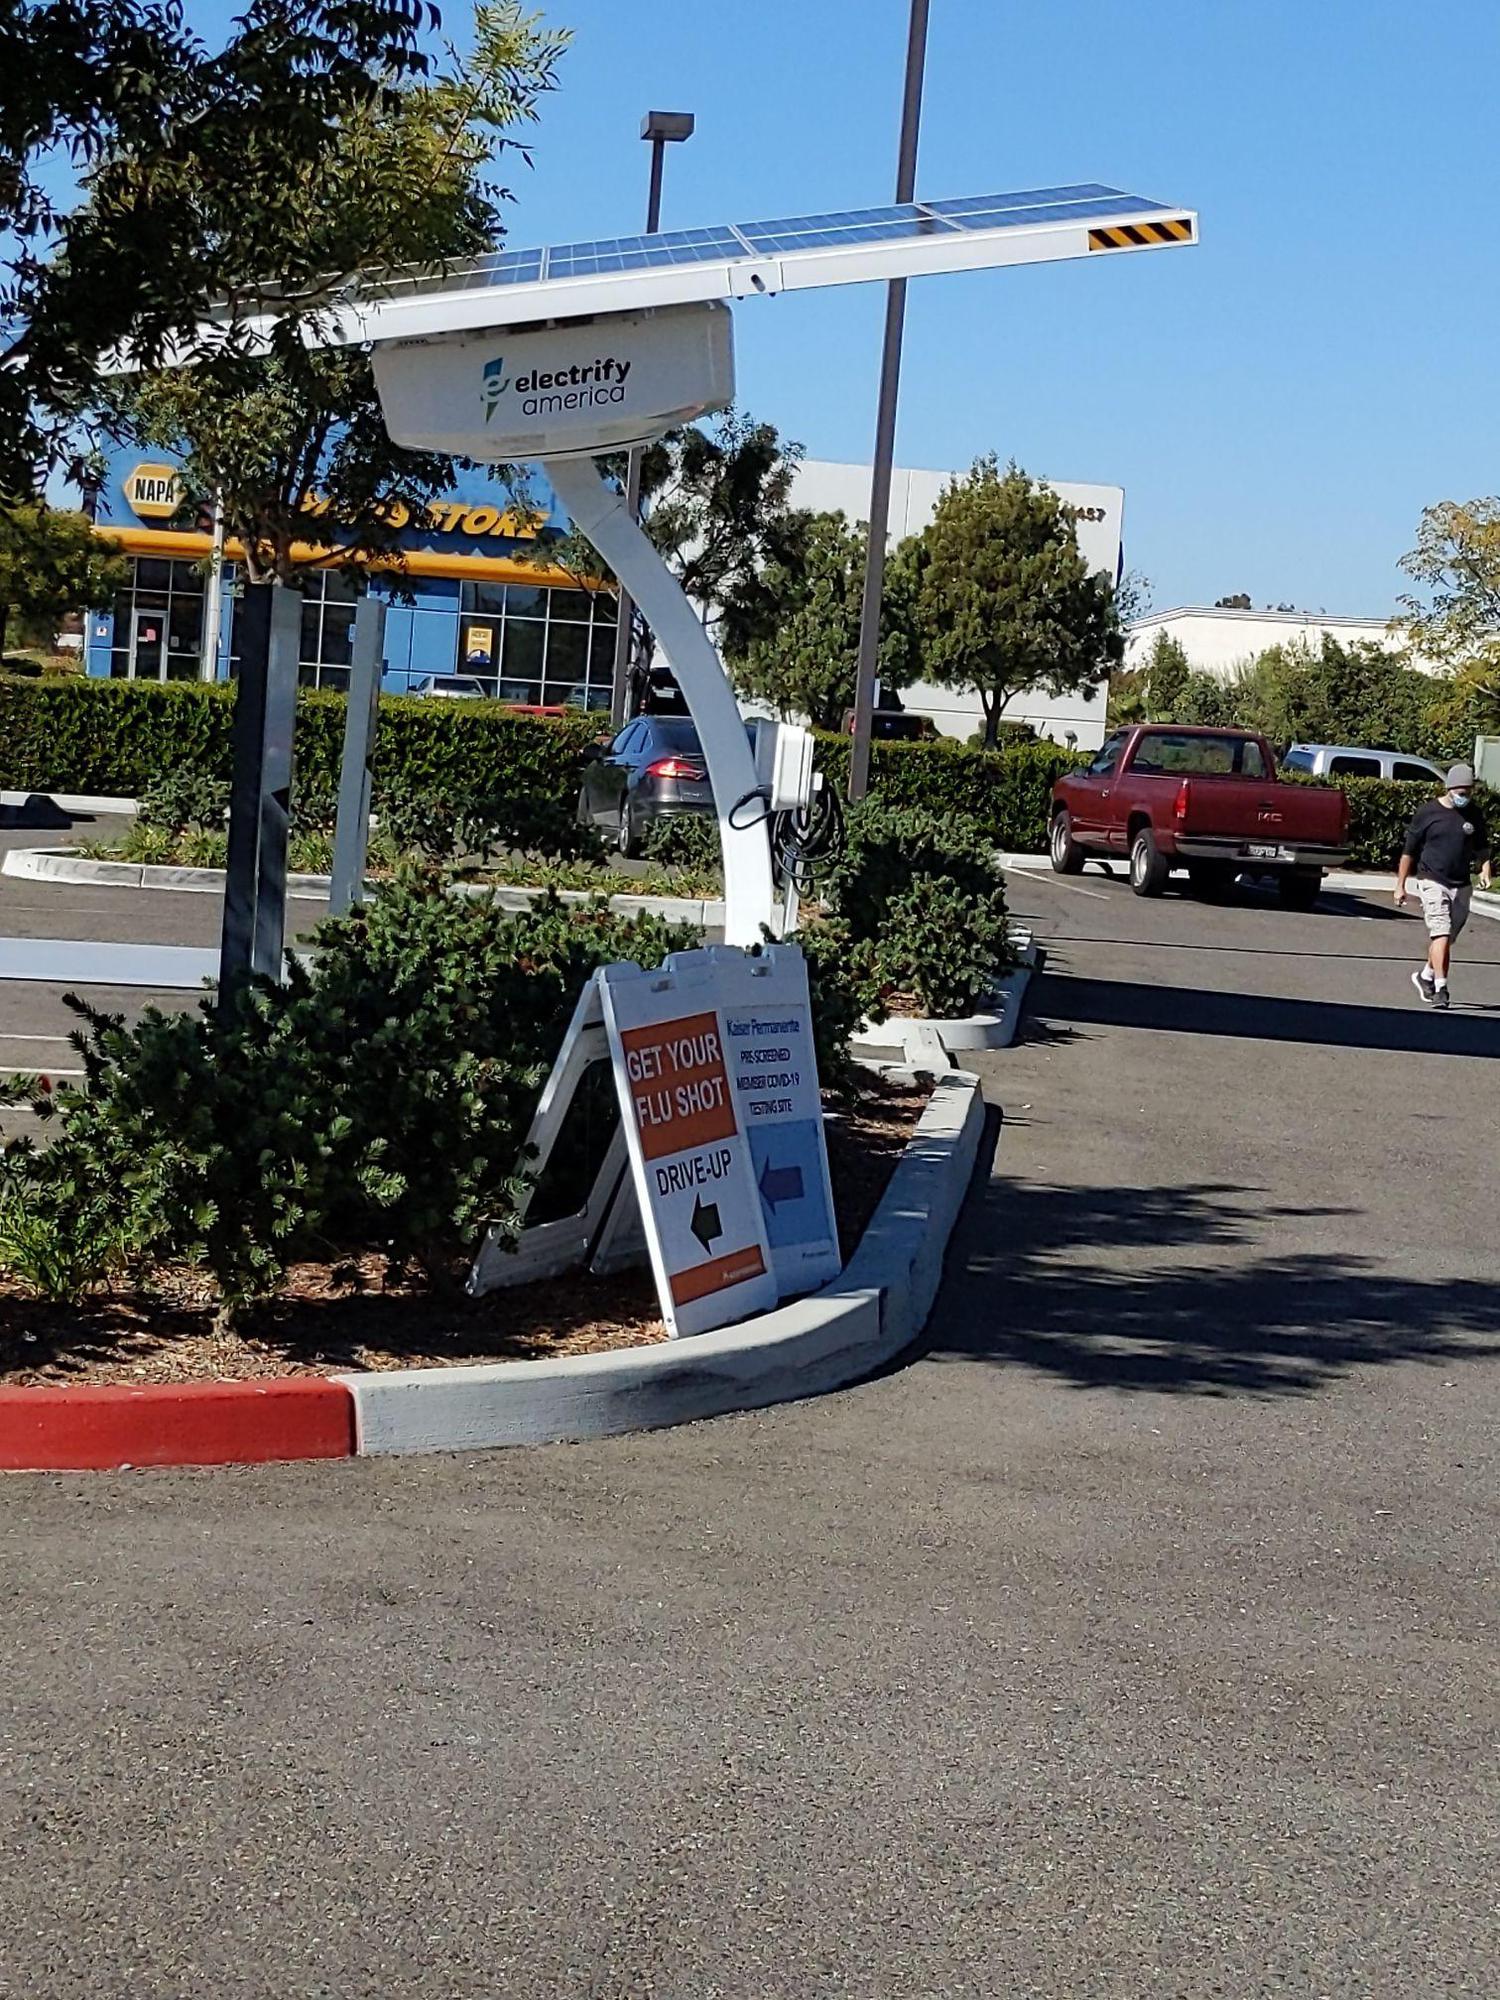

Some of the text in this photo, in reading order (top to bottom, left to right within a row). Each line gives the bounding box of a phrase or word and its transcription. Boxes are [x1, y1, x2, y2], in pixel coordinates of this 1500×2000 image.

[515, 358, 631, 393] electrify
[522, 386, 625, 416] america
[135, 478, 174, 503] NAPA
[627, 1032, 721, 1082] GET YOUR
[636, 1076, 724, 1128] FLU SHOT
[777, 1098, 793, 1113] SITE
[655, 1149, 732, 1196] DRIVE-UP
